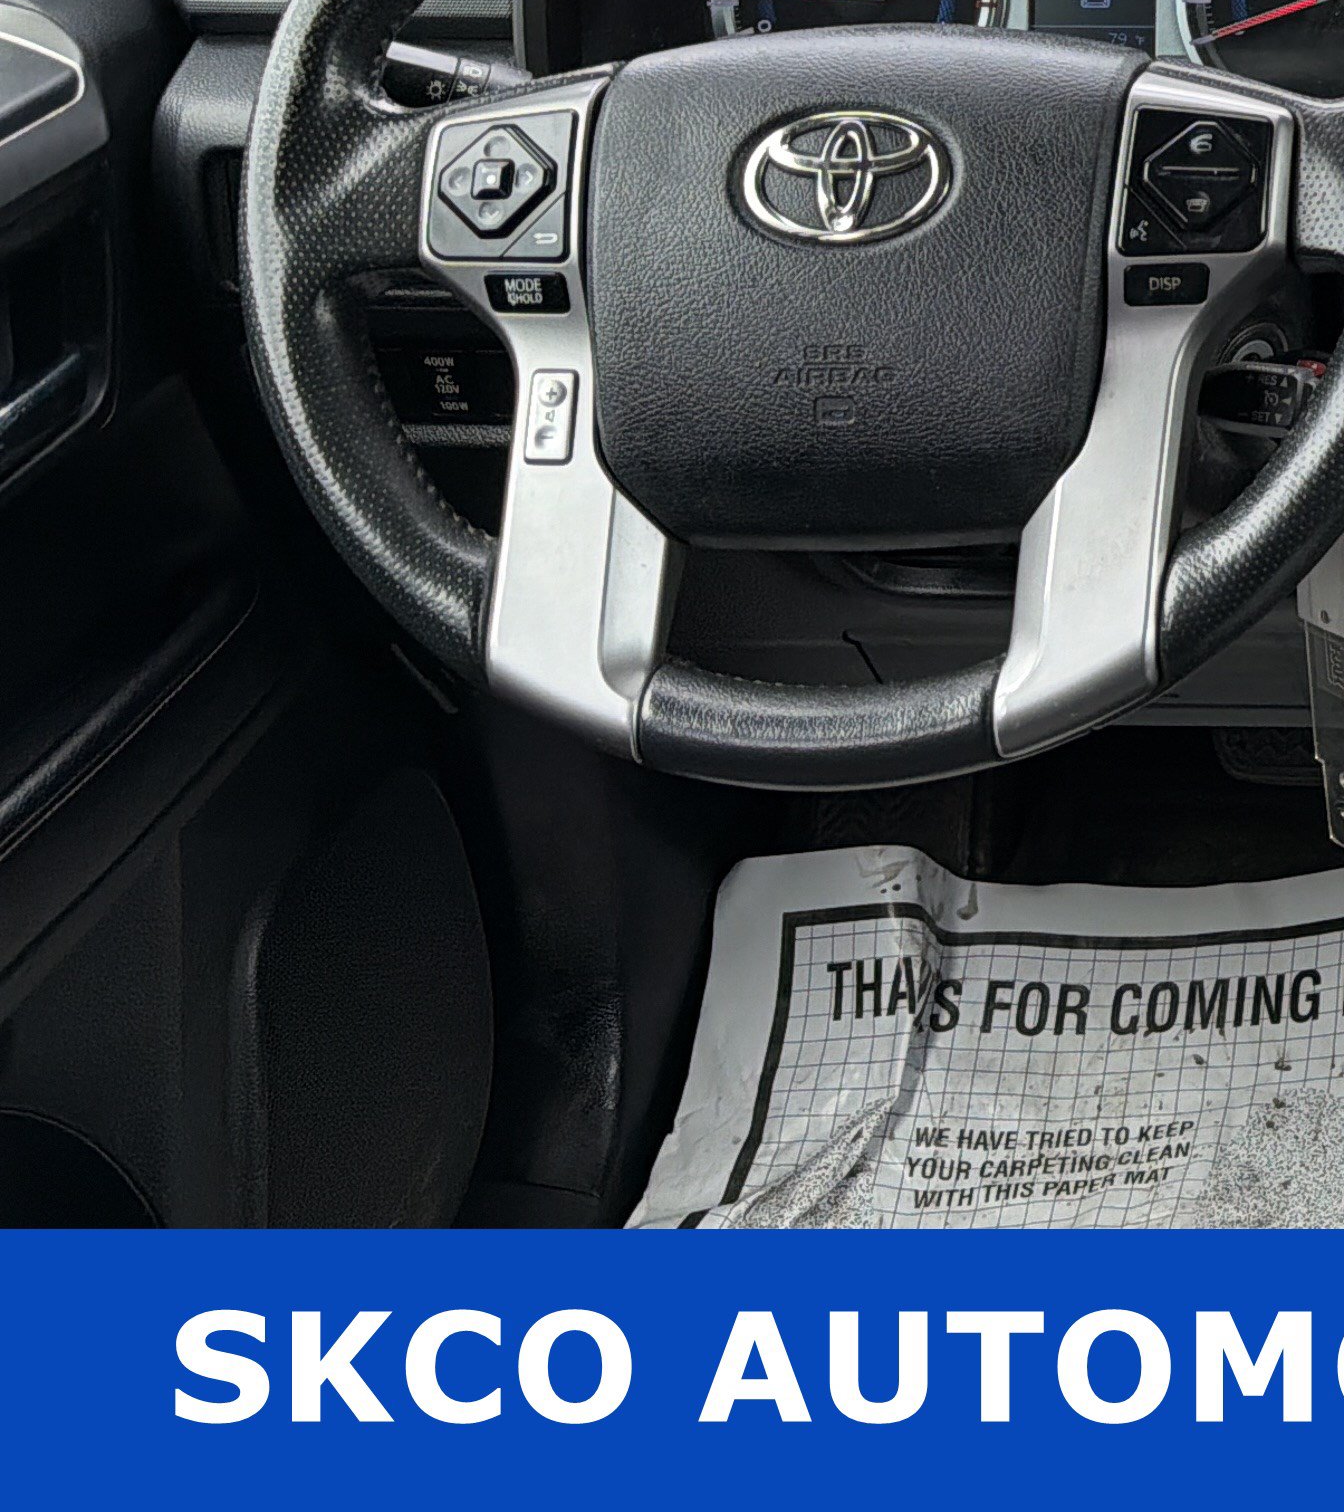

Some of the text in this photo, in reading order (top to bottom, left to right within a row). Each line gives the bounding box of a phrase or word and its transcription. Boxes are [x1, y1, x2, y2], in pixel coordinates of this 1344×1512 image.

[757, 19, 773, 33] 0
[504, 277, 542, 292] MODE
[1149, 276, 1182, 291] DISP
[516, 293, 543, 304] HOLD
[424, 356, 455, 367] 400W
[436, 374, 454, 385] AC
[981, 981, 1087, 1036] FOR
[1110, 968, 1322, 1037] COMING
[914, 1119, 1196, 1151] WE HAVE TRIED TO KEEP
[907, 1141, 1192, 1181] YOUR CARPETING CLEAN
[914, 1165, 1175, 1209] WITH THIS PAPER MAT
